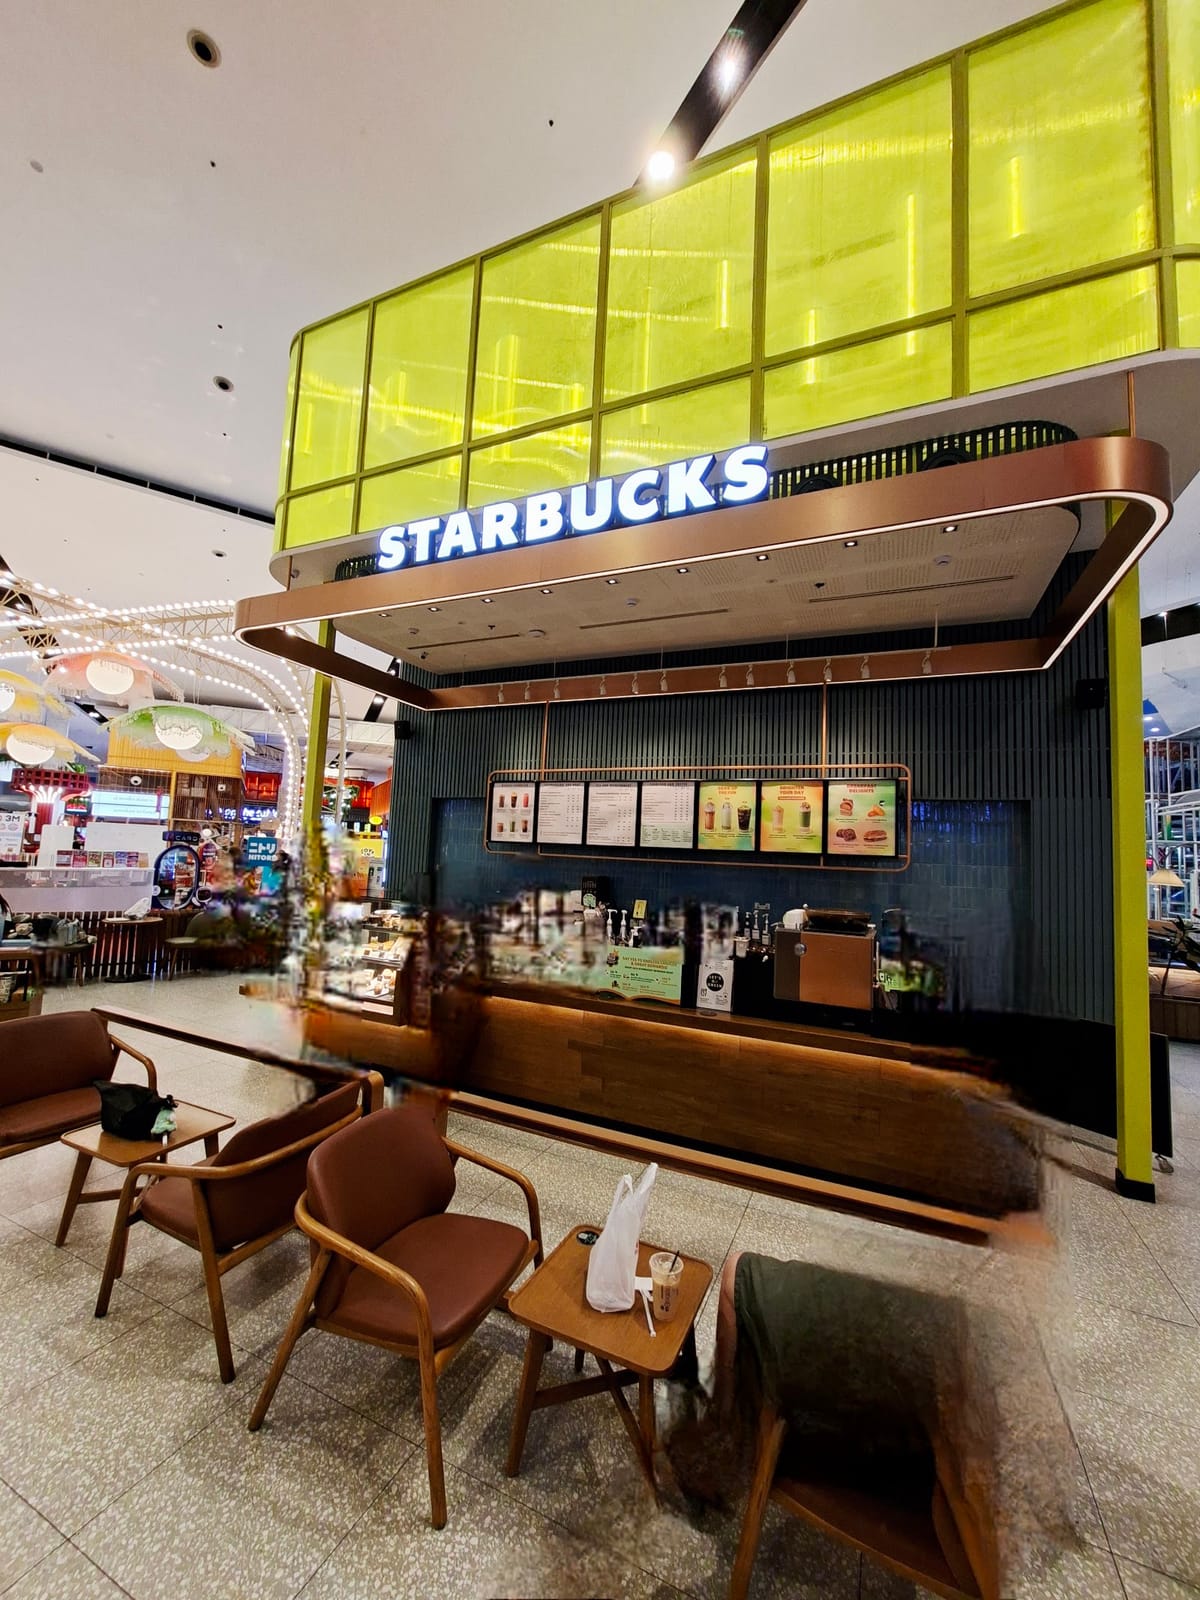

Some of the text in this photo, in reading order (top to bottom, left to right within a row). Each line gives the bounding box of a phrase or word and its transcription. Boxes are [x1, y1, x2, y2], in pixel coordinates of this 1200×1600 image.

[378, 445, 768, 571] STARBUCKS
[249, 842, 276, 854] ニトリ
